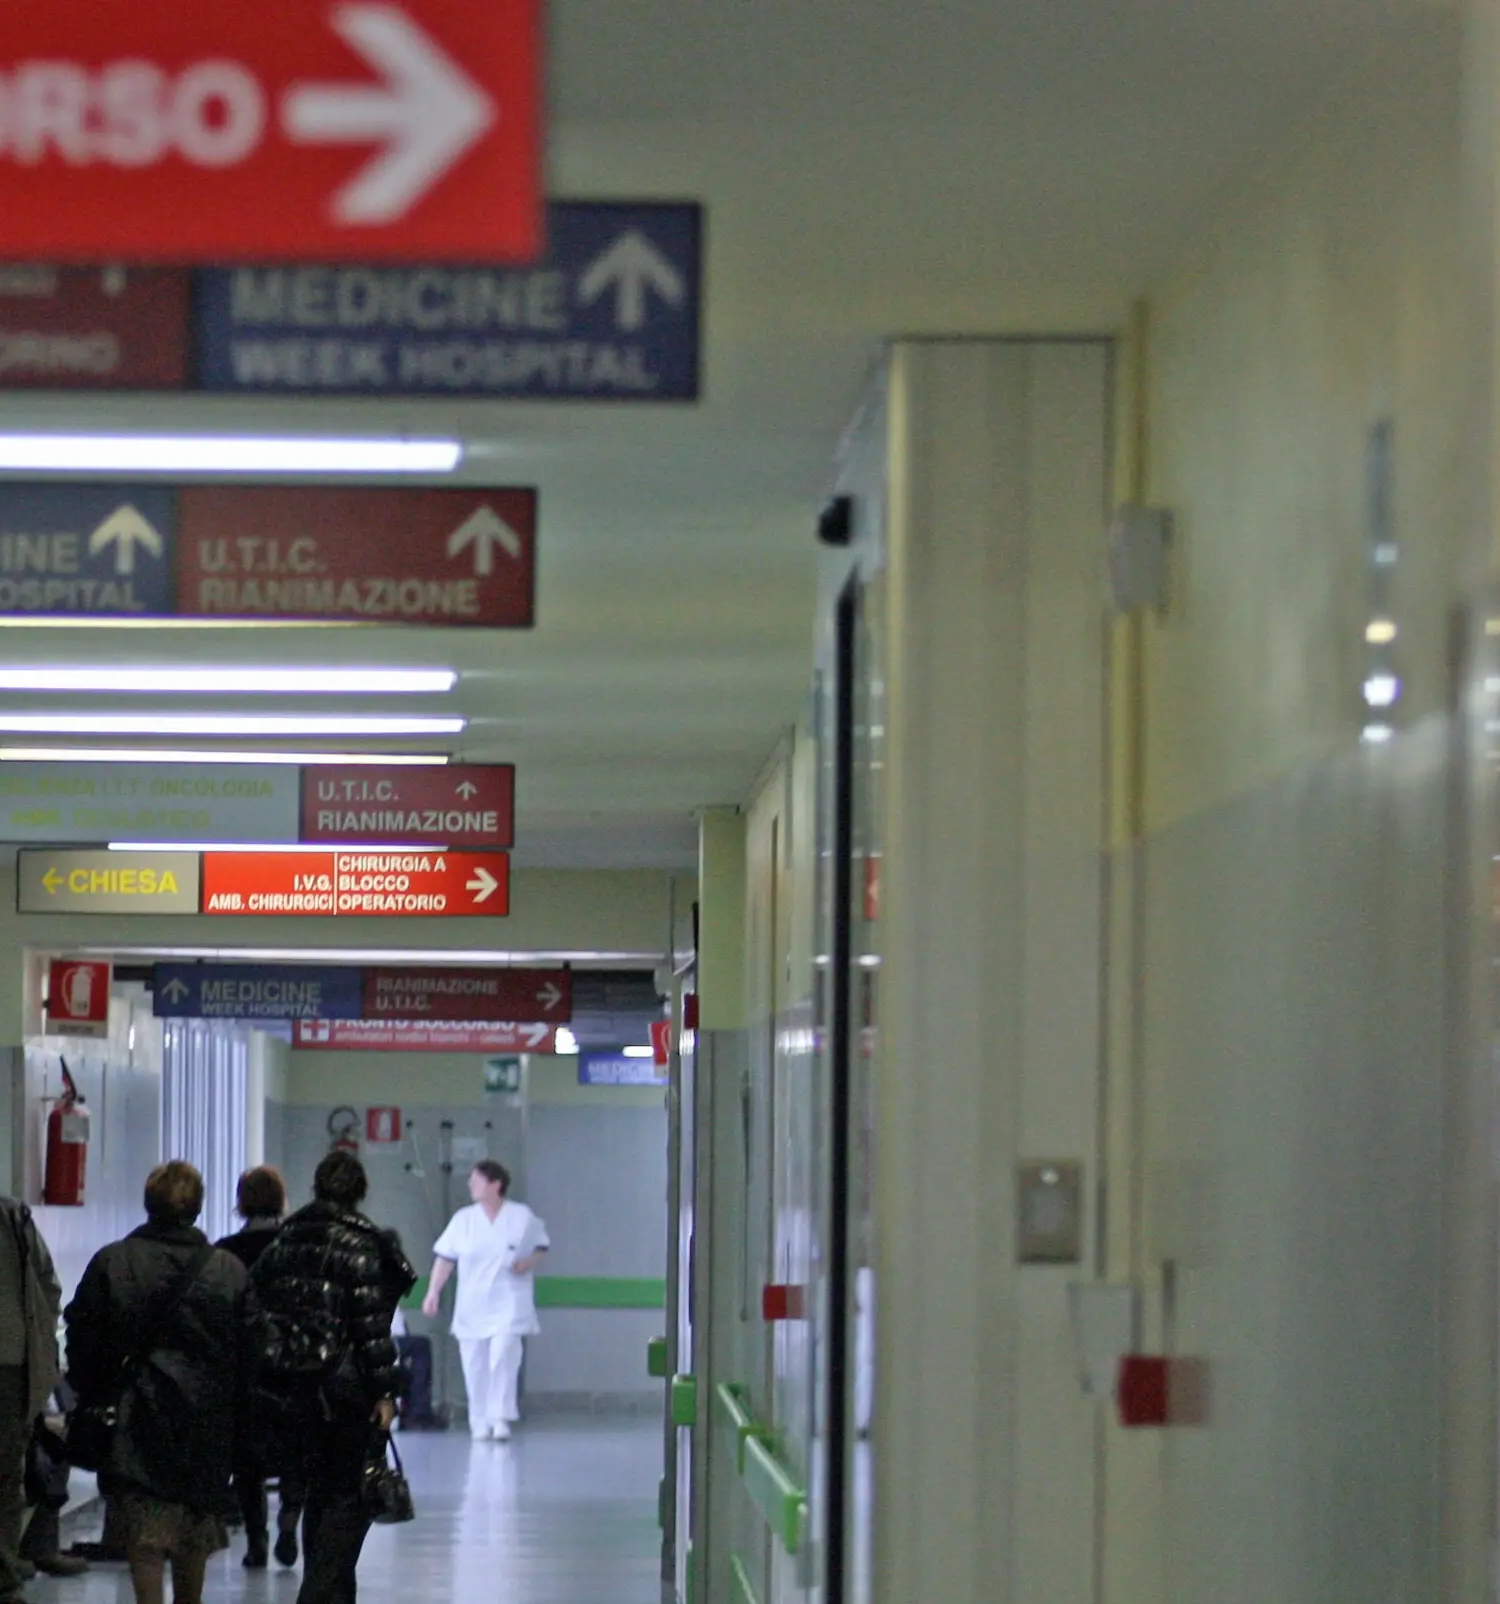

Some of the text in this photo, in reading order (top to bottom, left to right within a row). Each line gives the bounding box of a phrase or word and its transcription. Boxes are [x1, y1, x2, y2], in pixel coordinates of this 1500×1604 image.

[231, 266, 568, 329] MEDICINE
[231, 339, 659, 390] WEEK HOSPITAL
[200, 536, 328, 573] U.T.I.C.
[199, 578, 481, 615] RIANIMAZIONE
[317, 780, 400, 801] U.T.I.C.
[317, 811, 499, 832] RIANIMAZIONE
[338, 855, 447, 872] CHIRURGIA A
[68, 868, 178, 895] CHIESA
[293, 875, 332, 891] I.V.G.
[338, 875, 410, 892] BLOCCO
[208, 893, 334, 911] AMB. CHIRURGICI
[338, 894, 447, 911] OPERATORIO
[201, 979, 322, 1003] MEDICINE
[376, 977, 499, 995] RIANIMAZIONE
[249, 1003, 319, 1017] HOSPITAL
[376, 995, 431, 1011] U.T.I.C.
